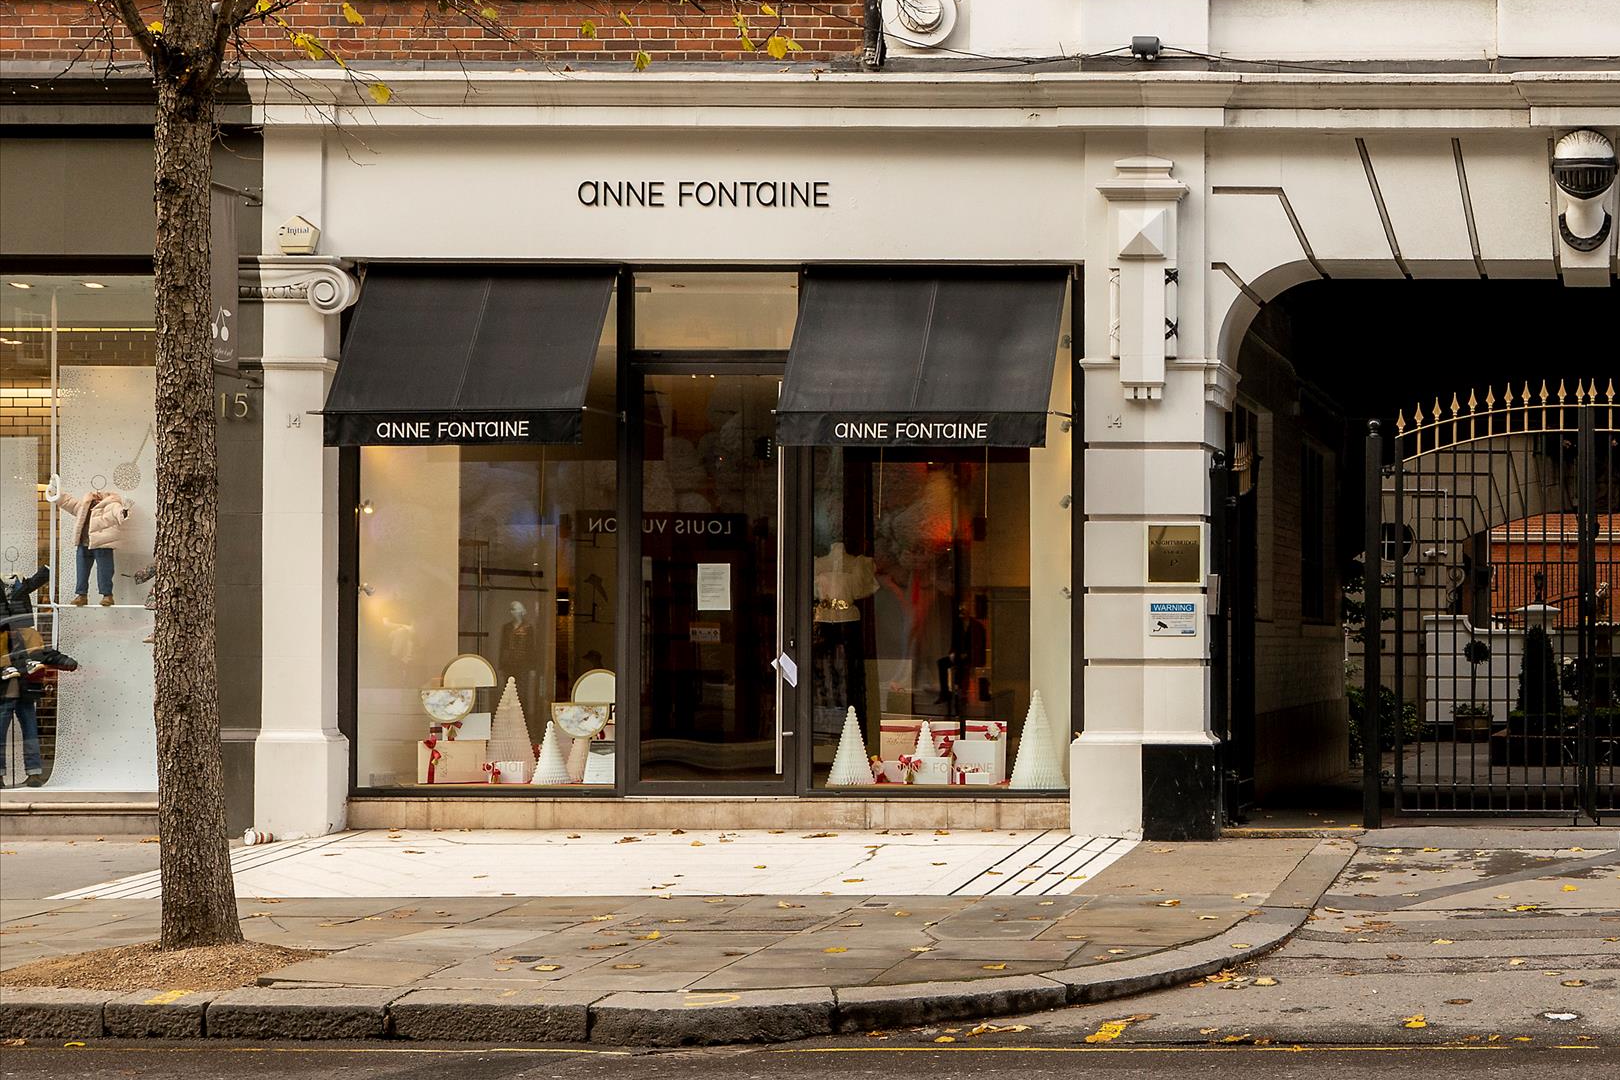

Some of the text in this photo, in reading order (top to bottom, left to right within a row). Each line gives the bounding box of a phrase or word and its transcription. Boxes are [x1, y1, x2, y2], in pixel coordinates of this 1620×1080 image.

[219, 393, 249, 419] 15
[287, 413, 301, 429] 14
[1106, 414, 1123, 429] 14
[1153, 604, 1192, 612] WARNING
